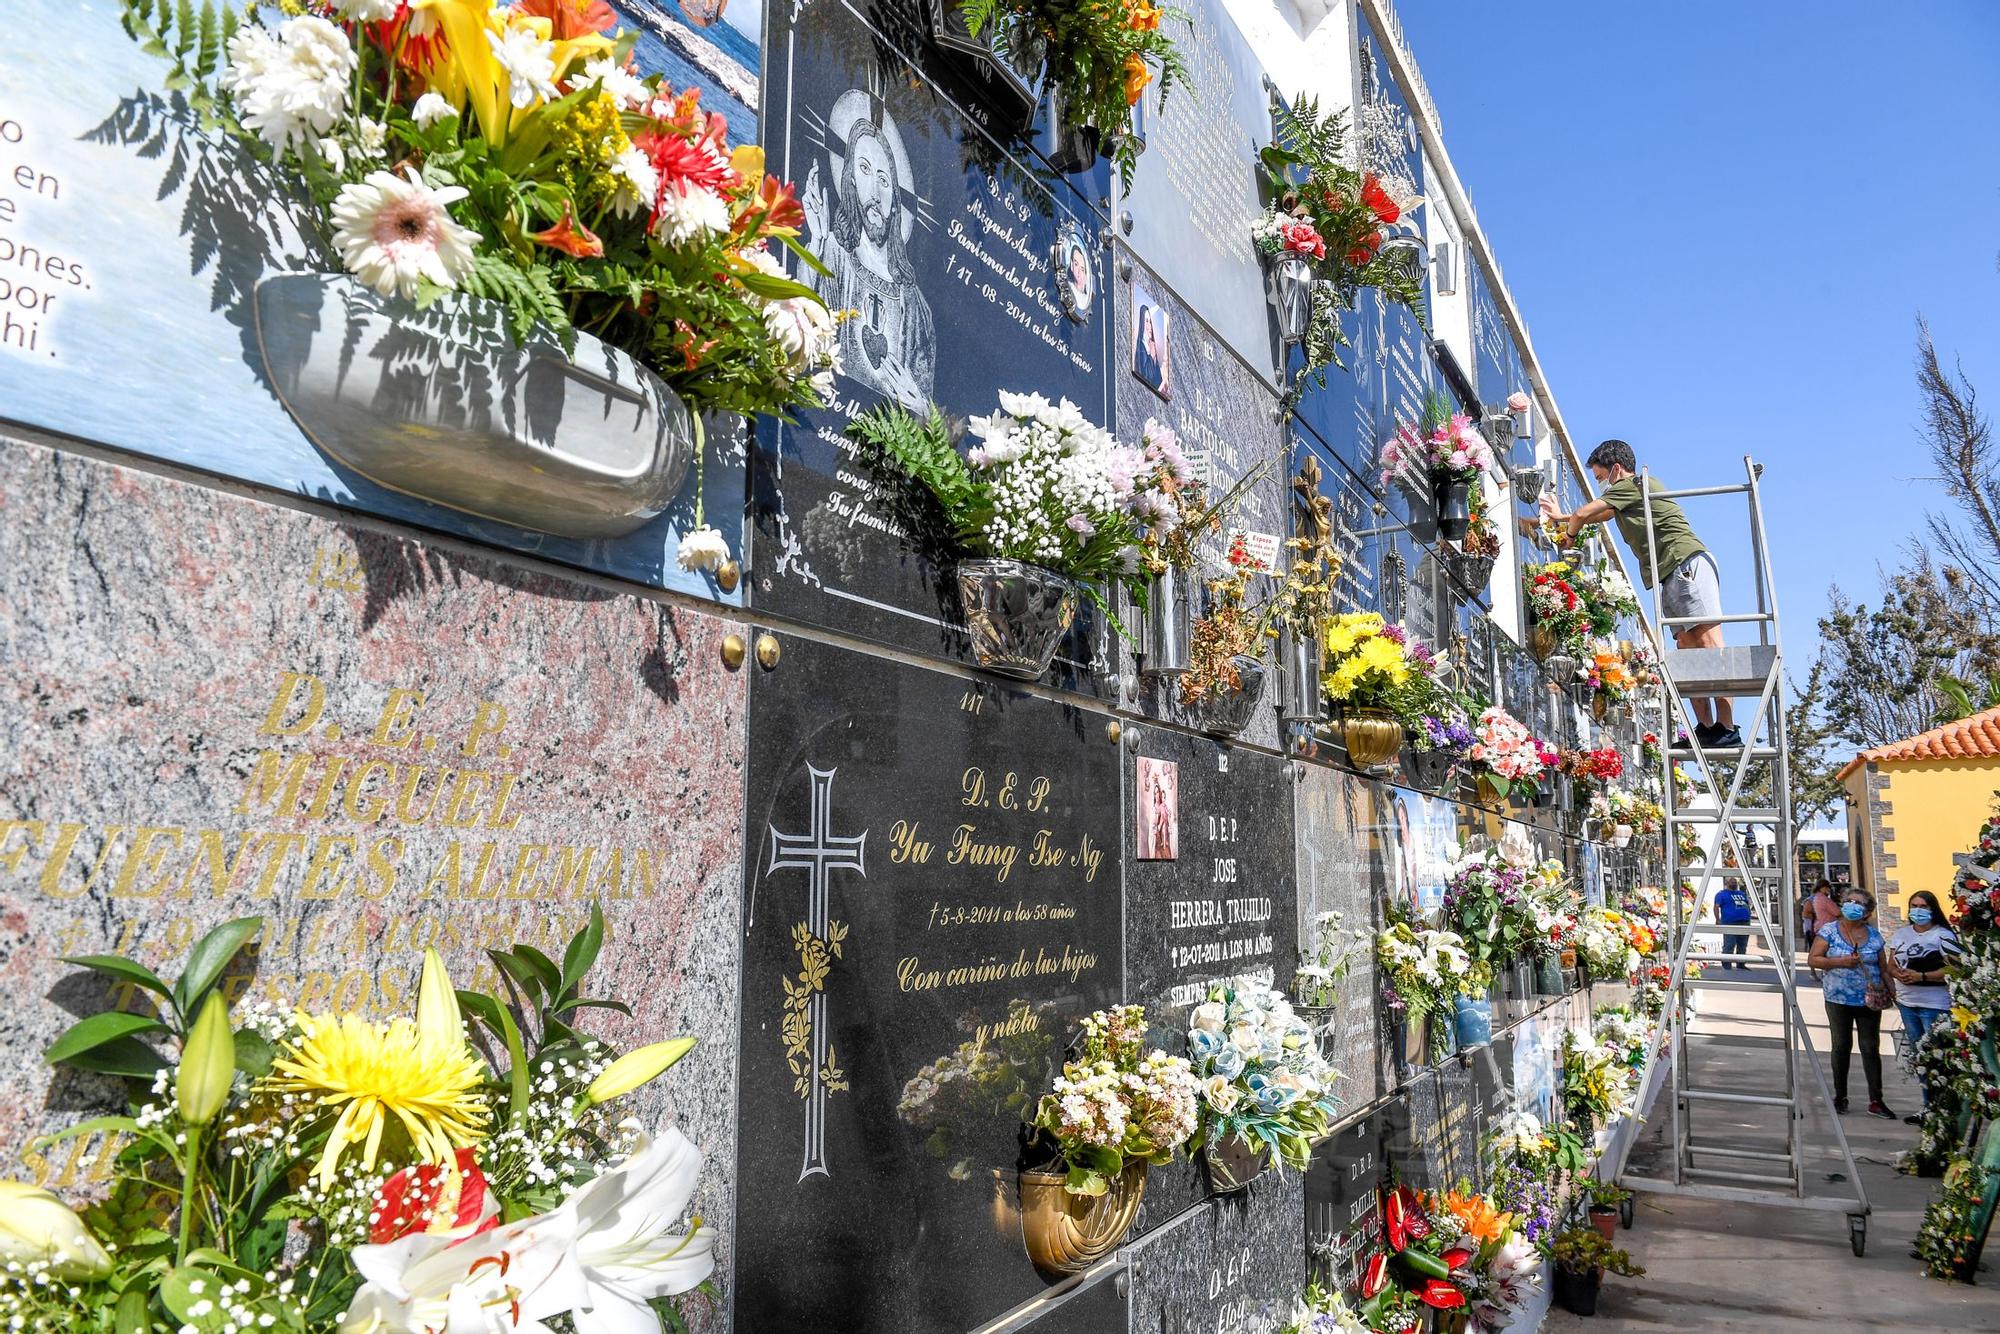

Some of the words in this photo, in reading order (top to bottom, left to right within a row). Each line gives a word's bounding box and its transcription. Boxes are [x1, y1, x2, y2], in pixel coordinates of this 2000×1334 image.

[968, 102, 988, 125] 118
[987, 175, 1001, 201] D.
[1004, 192, 1016, 214] E.
[966, 198, 1013, 243] Miguel
[1011, 234, 1049, 273] Ángel
[947, 218, 1006, 275] Santana
[1005, 266, 1022, 287] de
[1021, 276, 1036, 299] la
[1036, 286, 1063, 326] Cruz
[957, 266, 973, 285] 17
[982, 284, 997, 303] 08
[1006, 301, 1031, 328] 2011
[1041, 324, 1057, 347] los
[1070, 351, 1092, 373] años
[822, 387, 845, 412] Te
[1181, 406, 1239, 471] BARTOLOME
[826, 491, 853, 516] Tu
[848, 501, 908, 539] familia
[260, 670, 341, 741] D.
[374, 688, 437, 751] E.
[464, 699, 511, 761] P.
[960, 691, 984, 716] 117
[1218, 753, 1228, 773] 112
[236, 748, 527, 832] MIGUEL
[962, 766, 988, 809] D.
[999, 771, 1018, 811] E.
[1028, 776, 1050, 813] P.
[889, 819, 935, 865] Yu
[947, 823, 1021, 883] Fung
[1028, 829, 1067, 869] Tse
[1070, 832, 1104, 883] Ng
[1209, 816, 1218, 841] D.
[1220, 817, 1229, 842] E.
[1231, 818, 1239, 842] P.
[0, 819, 407, 901] FUENTES
[421, 840, 668, 900] ALEMAN
[1213, 858, 1237, 883] JOSE
[382, 914, 464, 955] LOS
[940, 901, 1001, 926] 5-8-2011
[1003, 906, 1015, 921] a
[1014, 901, 1034, 921] los
[1033, 902, 1048, 921] 58
[1048, 904, 1076, 921] años
[1171, 900, 1223, 929] HERRERA
[1226, 897, 1271, 922] TRUJILLO
[896, 957, 945, 993] Con
[946, 954, 1010, 987] cariño
[1010, 948, 1035, 979] de
[1034, 948, 1062, 976] tus
[1061, 944, 1099, 985] hijos
[1180, 942, 1220, 968] 12-07-2011
[1222, 940, 1228, 961] A
[1229, 938, 1242, 959] LOS
[1254, 932, 1273, 955] AÑOS
[1171, 981, 1207, 1009] SIEMPRE
[975, 1020, 992, 1056] y
[992, 1004, 1042, 1038] nieta
[1209, 1269, 1224, 1301] D.
[1227, 1255, 1238, 1288] E.
